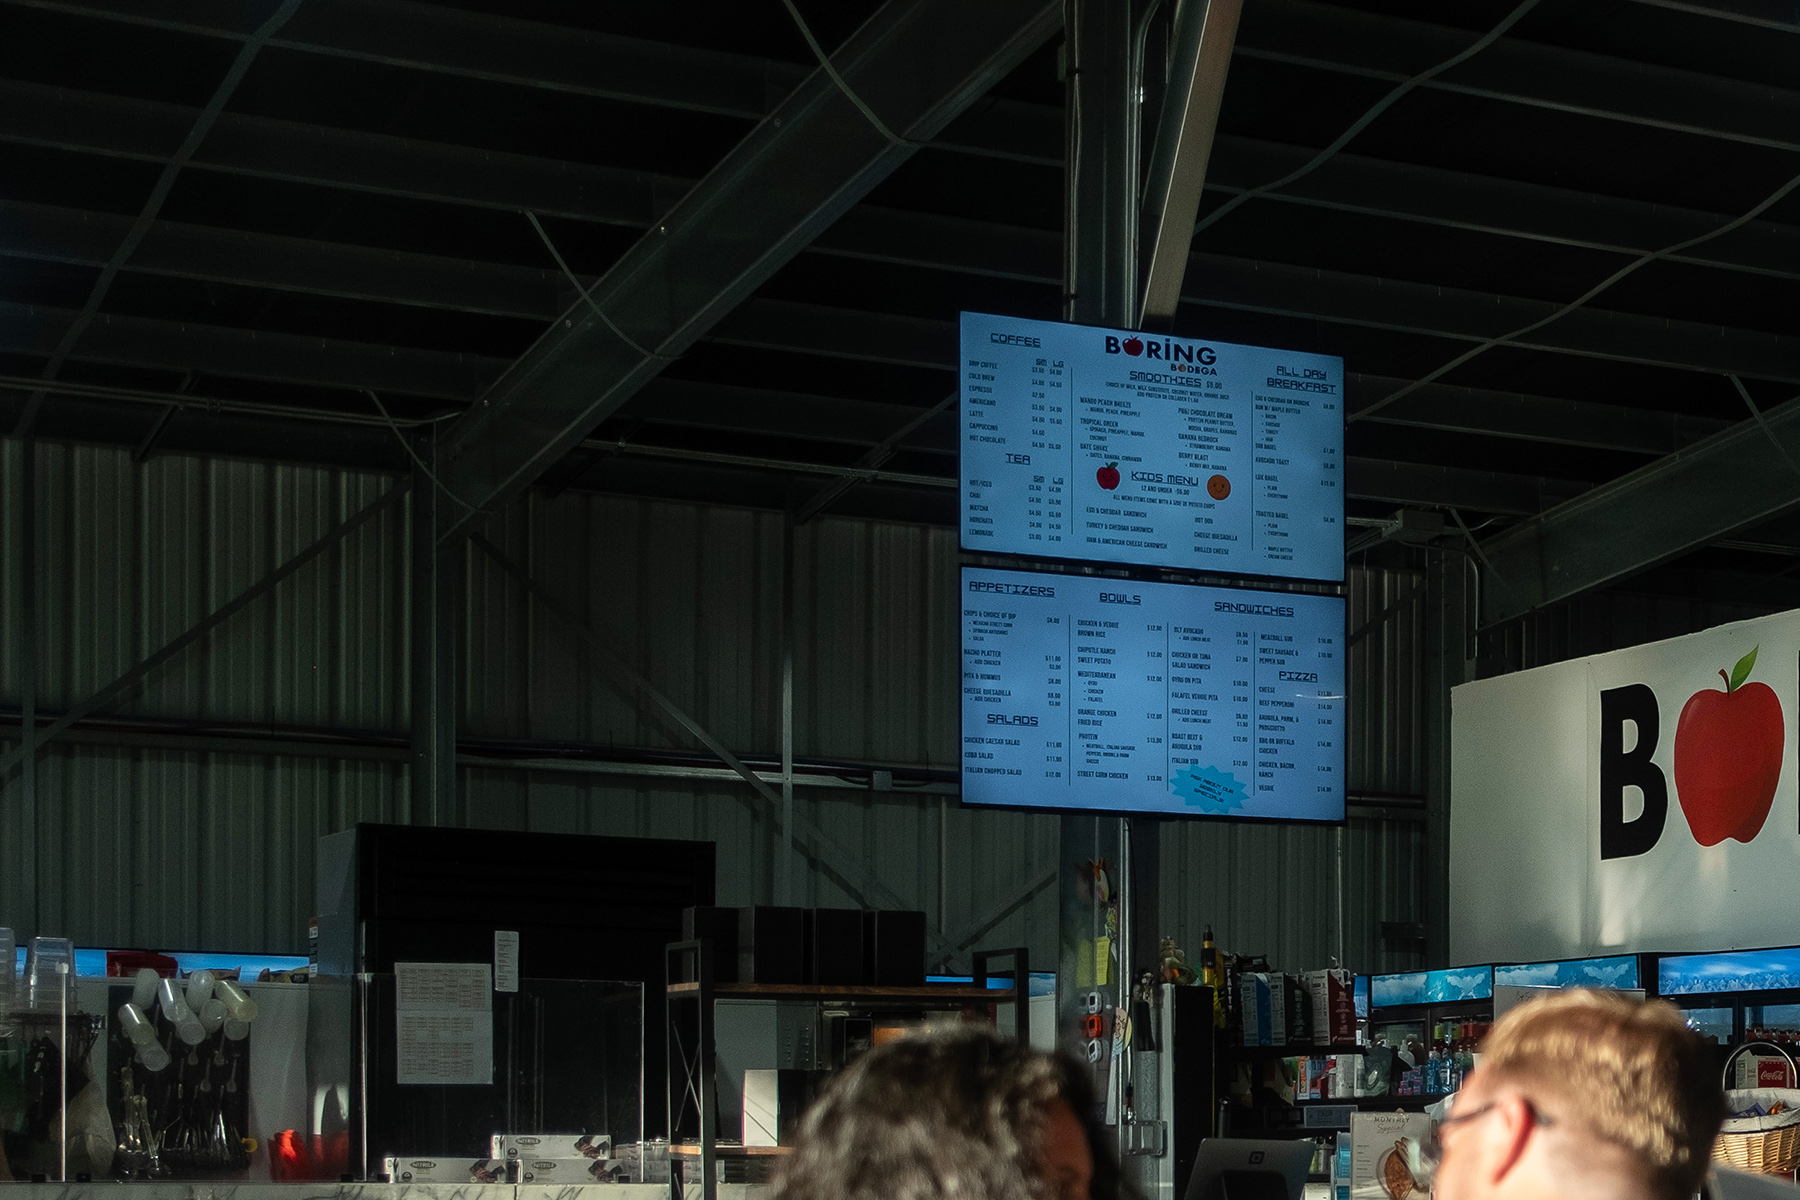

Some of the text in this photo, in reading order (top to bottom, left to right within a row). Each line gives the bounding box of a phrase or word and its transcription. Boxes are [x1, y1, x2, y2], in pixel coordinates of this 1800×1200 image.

[990, 333, 1041, 346] COFFEE
[1105, 335, 1217, 365] BORING
[1053, 360, 1064, 368] LG
[1171, 363, 1218, 376] BODEGA
[1129, 371, 1202, 387] SMOOTHIES
[1276, 366, 1327, 379] ALL DAY
[1267, 378, 1336, 393] BREAKFAST
[1006, 453, 1031, 464] TEA
[1053, 477, 1064, 485] LG
[1131, 471, 1199, 486] KIDS MENU
[969, 581, 1055, 597] APPETIZERS
[1099, 592, 1142, 605] BOWLS
[1214, 601, 1295, 617] SANDWICHES
[1279, 671, 1318, 682] PIZZA
[987, 714, 1038, 726] SALADS
[1760, 1070, 1784, 1081] Coca-Cola
